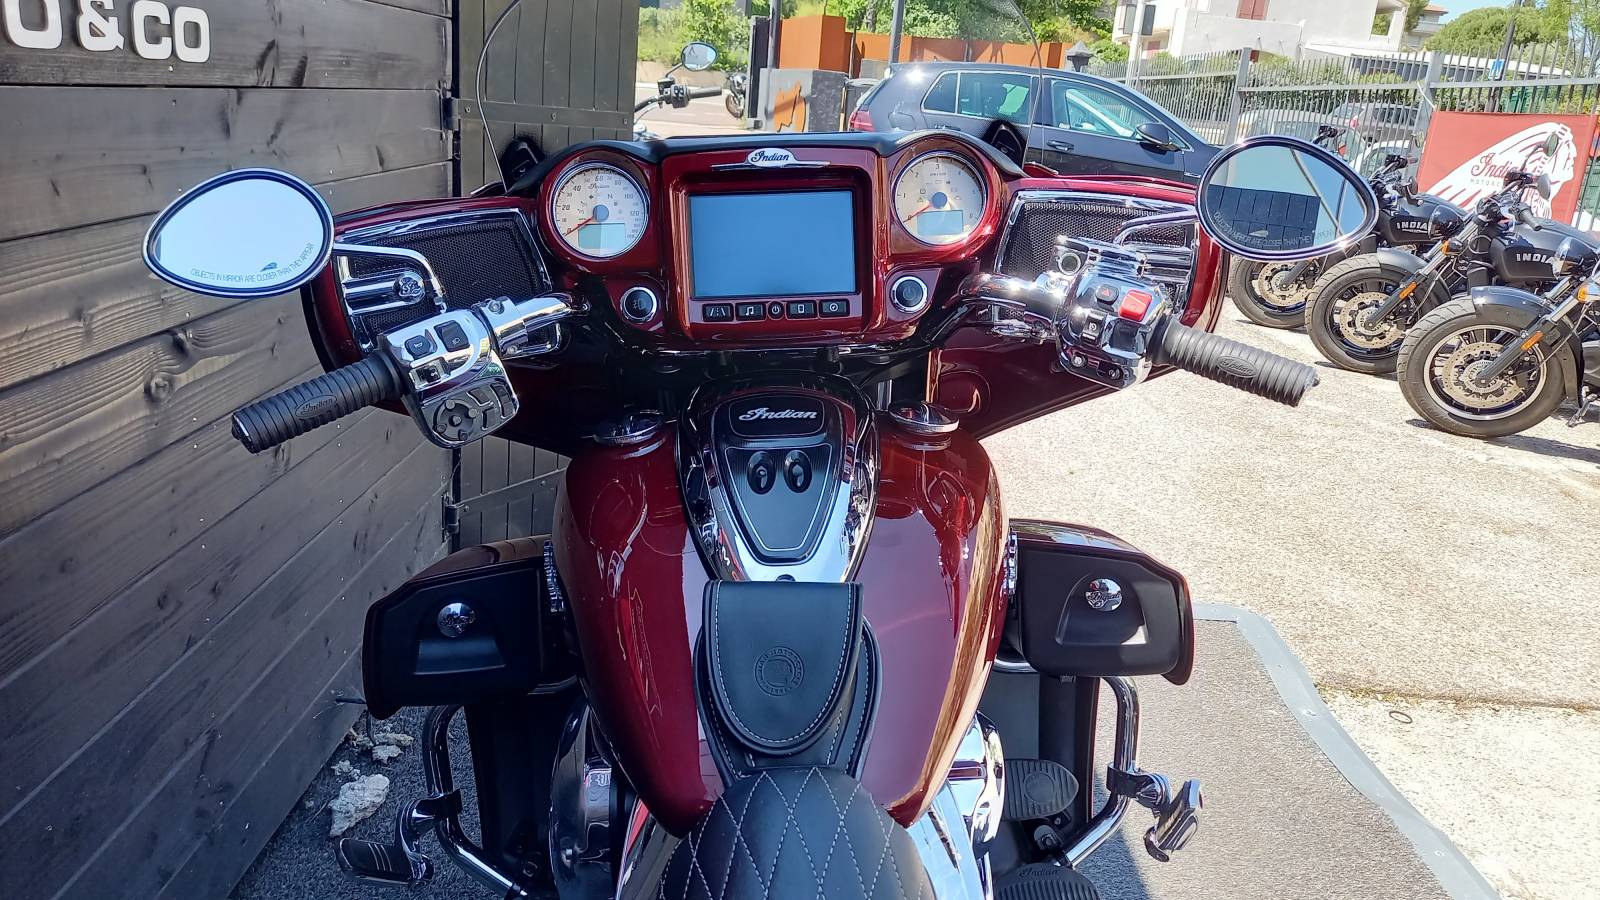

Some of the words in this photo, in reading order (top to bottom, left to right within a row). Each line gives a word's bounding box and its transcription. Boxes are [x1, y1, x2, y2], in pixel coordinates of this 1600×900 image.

[76, 0, 124, 51] &
[131, 0, 210, 62] CO
[750, 150, 790, 163] Indian
[1396, 221, 1428, 231] INDIA
[738, 407, 818, 421] Indian
